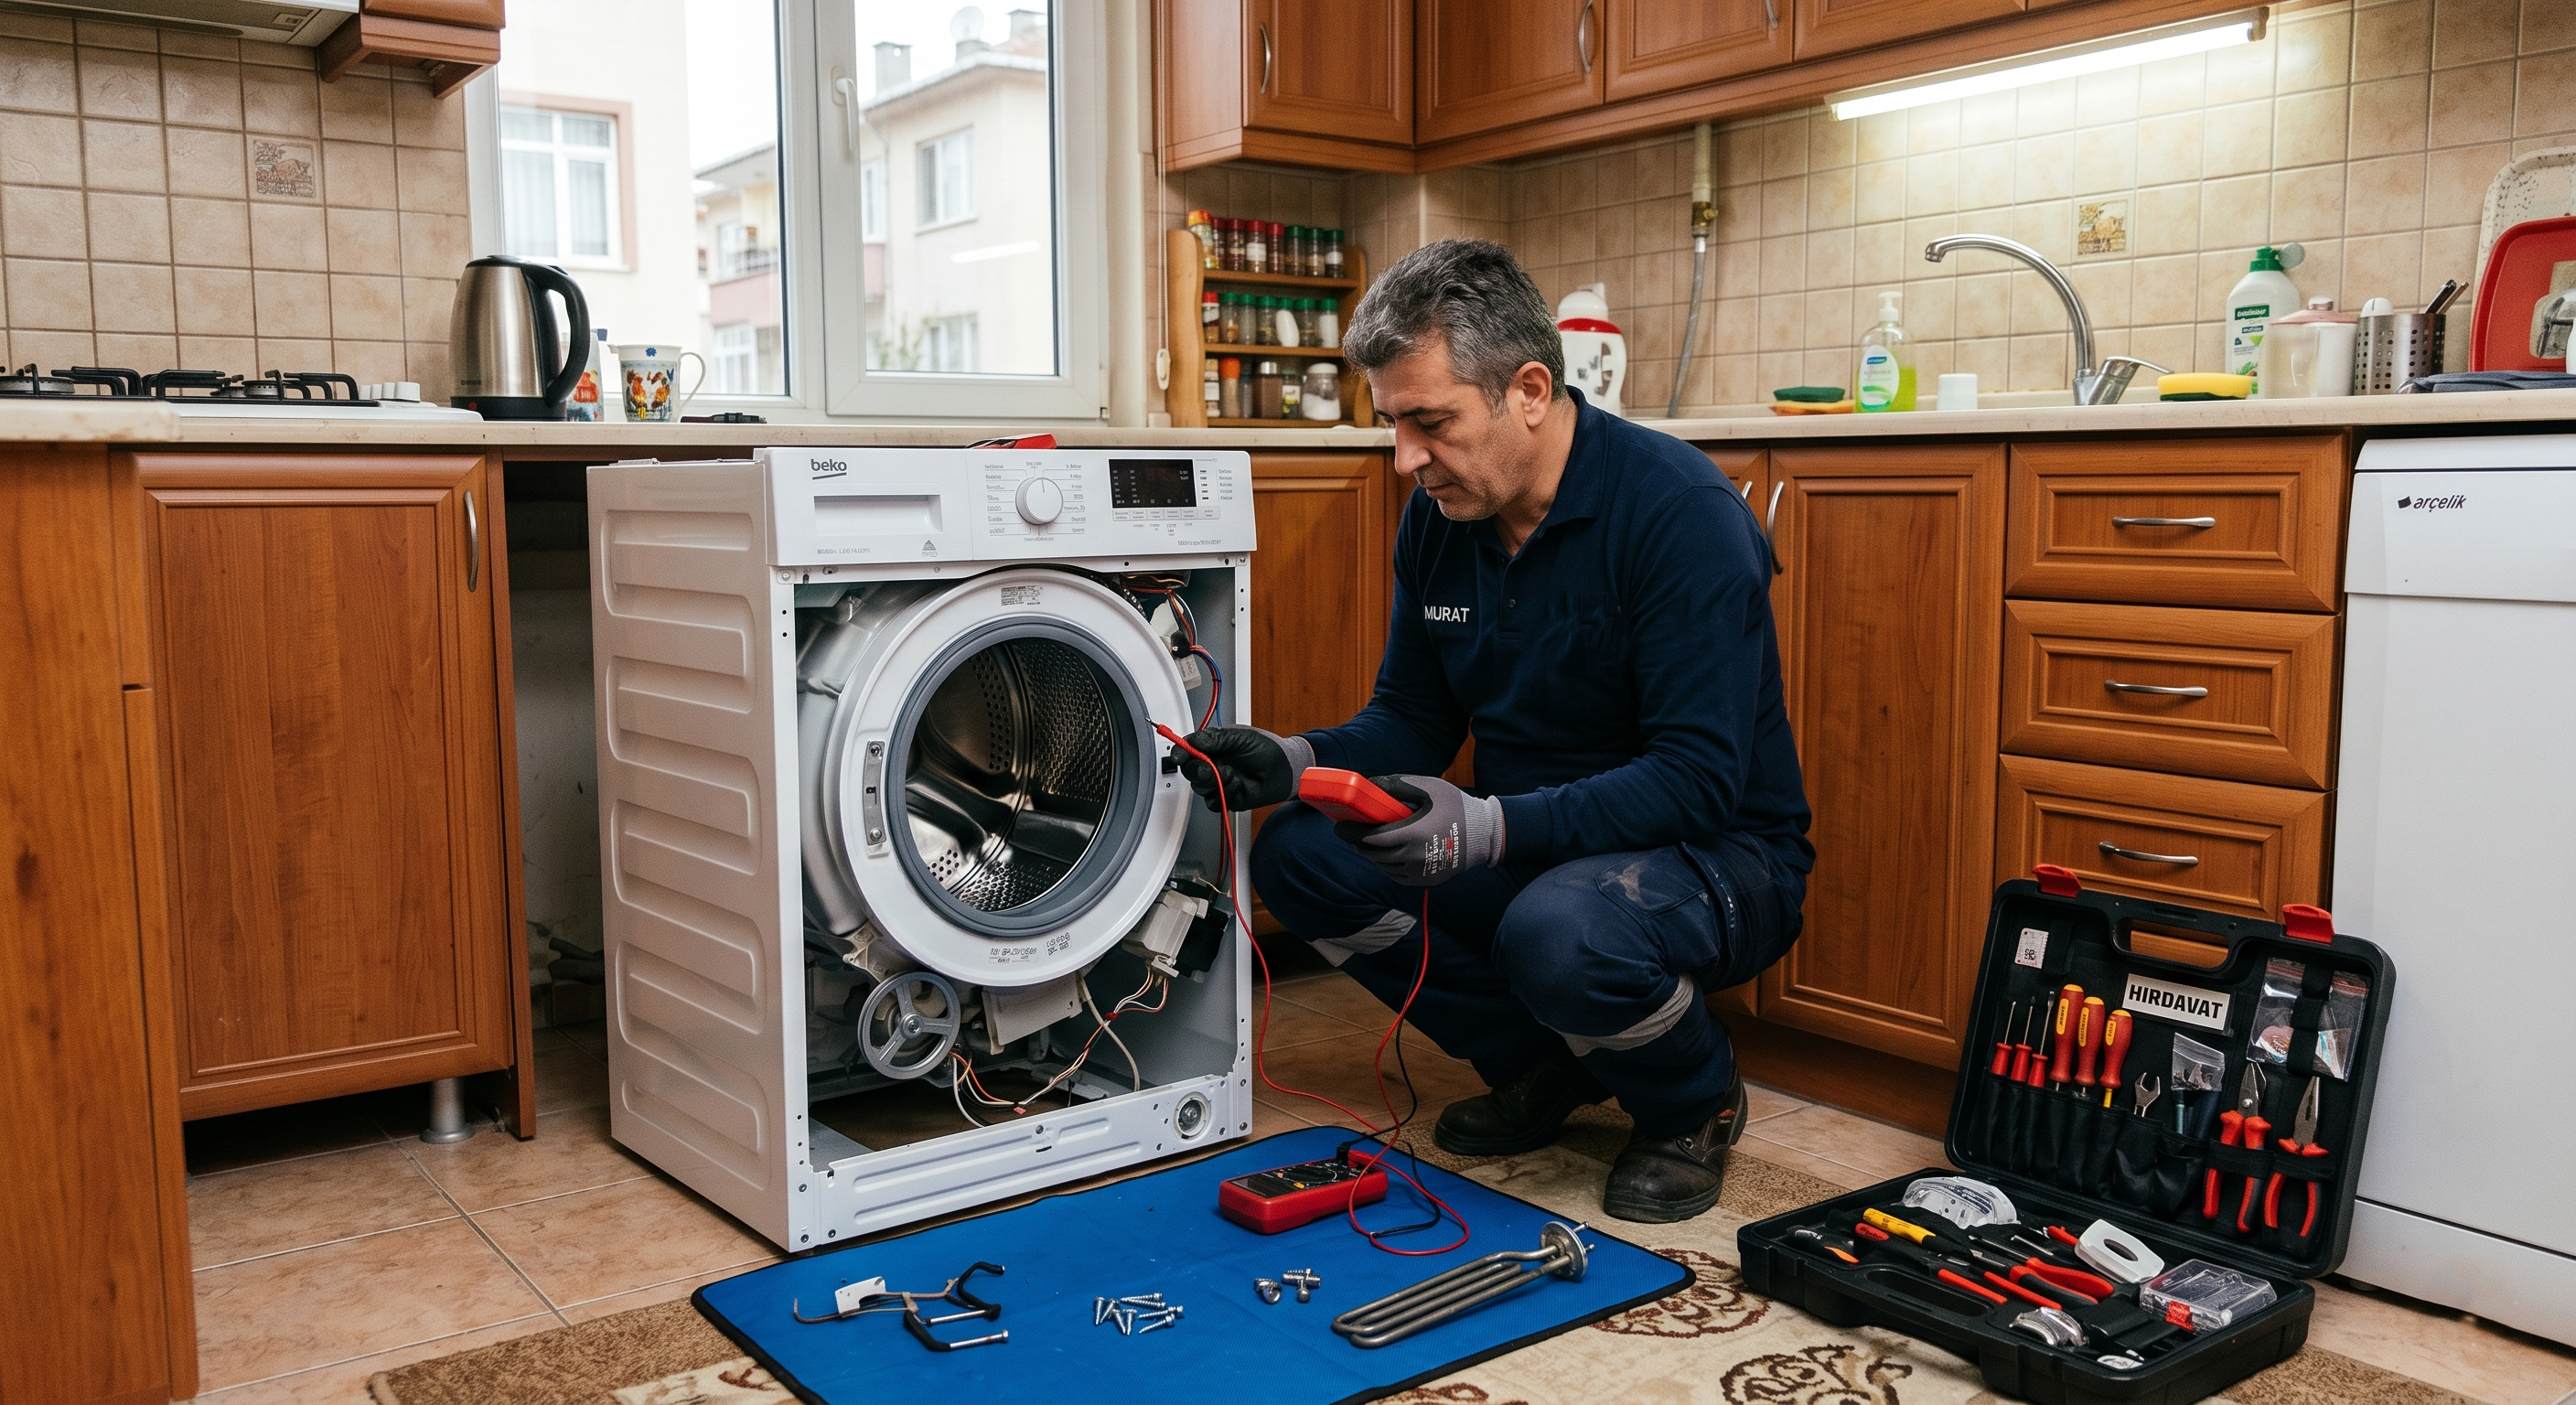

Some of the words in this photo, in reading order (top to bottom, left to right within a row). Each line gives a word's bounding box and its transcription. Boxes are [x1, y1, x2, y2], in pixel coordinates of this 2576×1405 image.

[810, 458, 847, 471] beko
[2413, 495, 2466, 512] arçelik
[1424, 605, 1470, 623] MURAT
[2128, 983, 2224, 1019] HIRDAVAT
